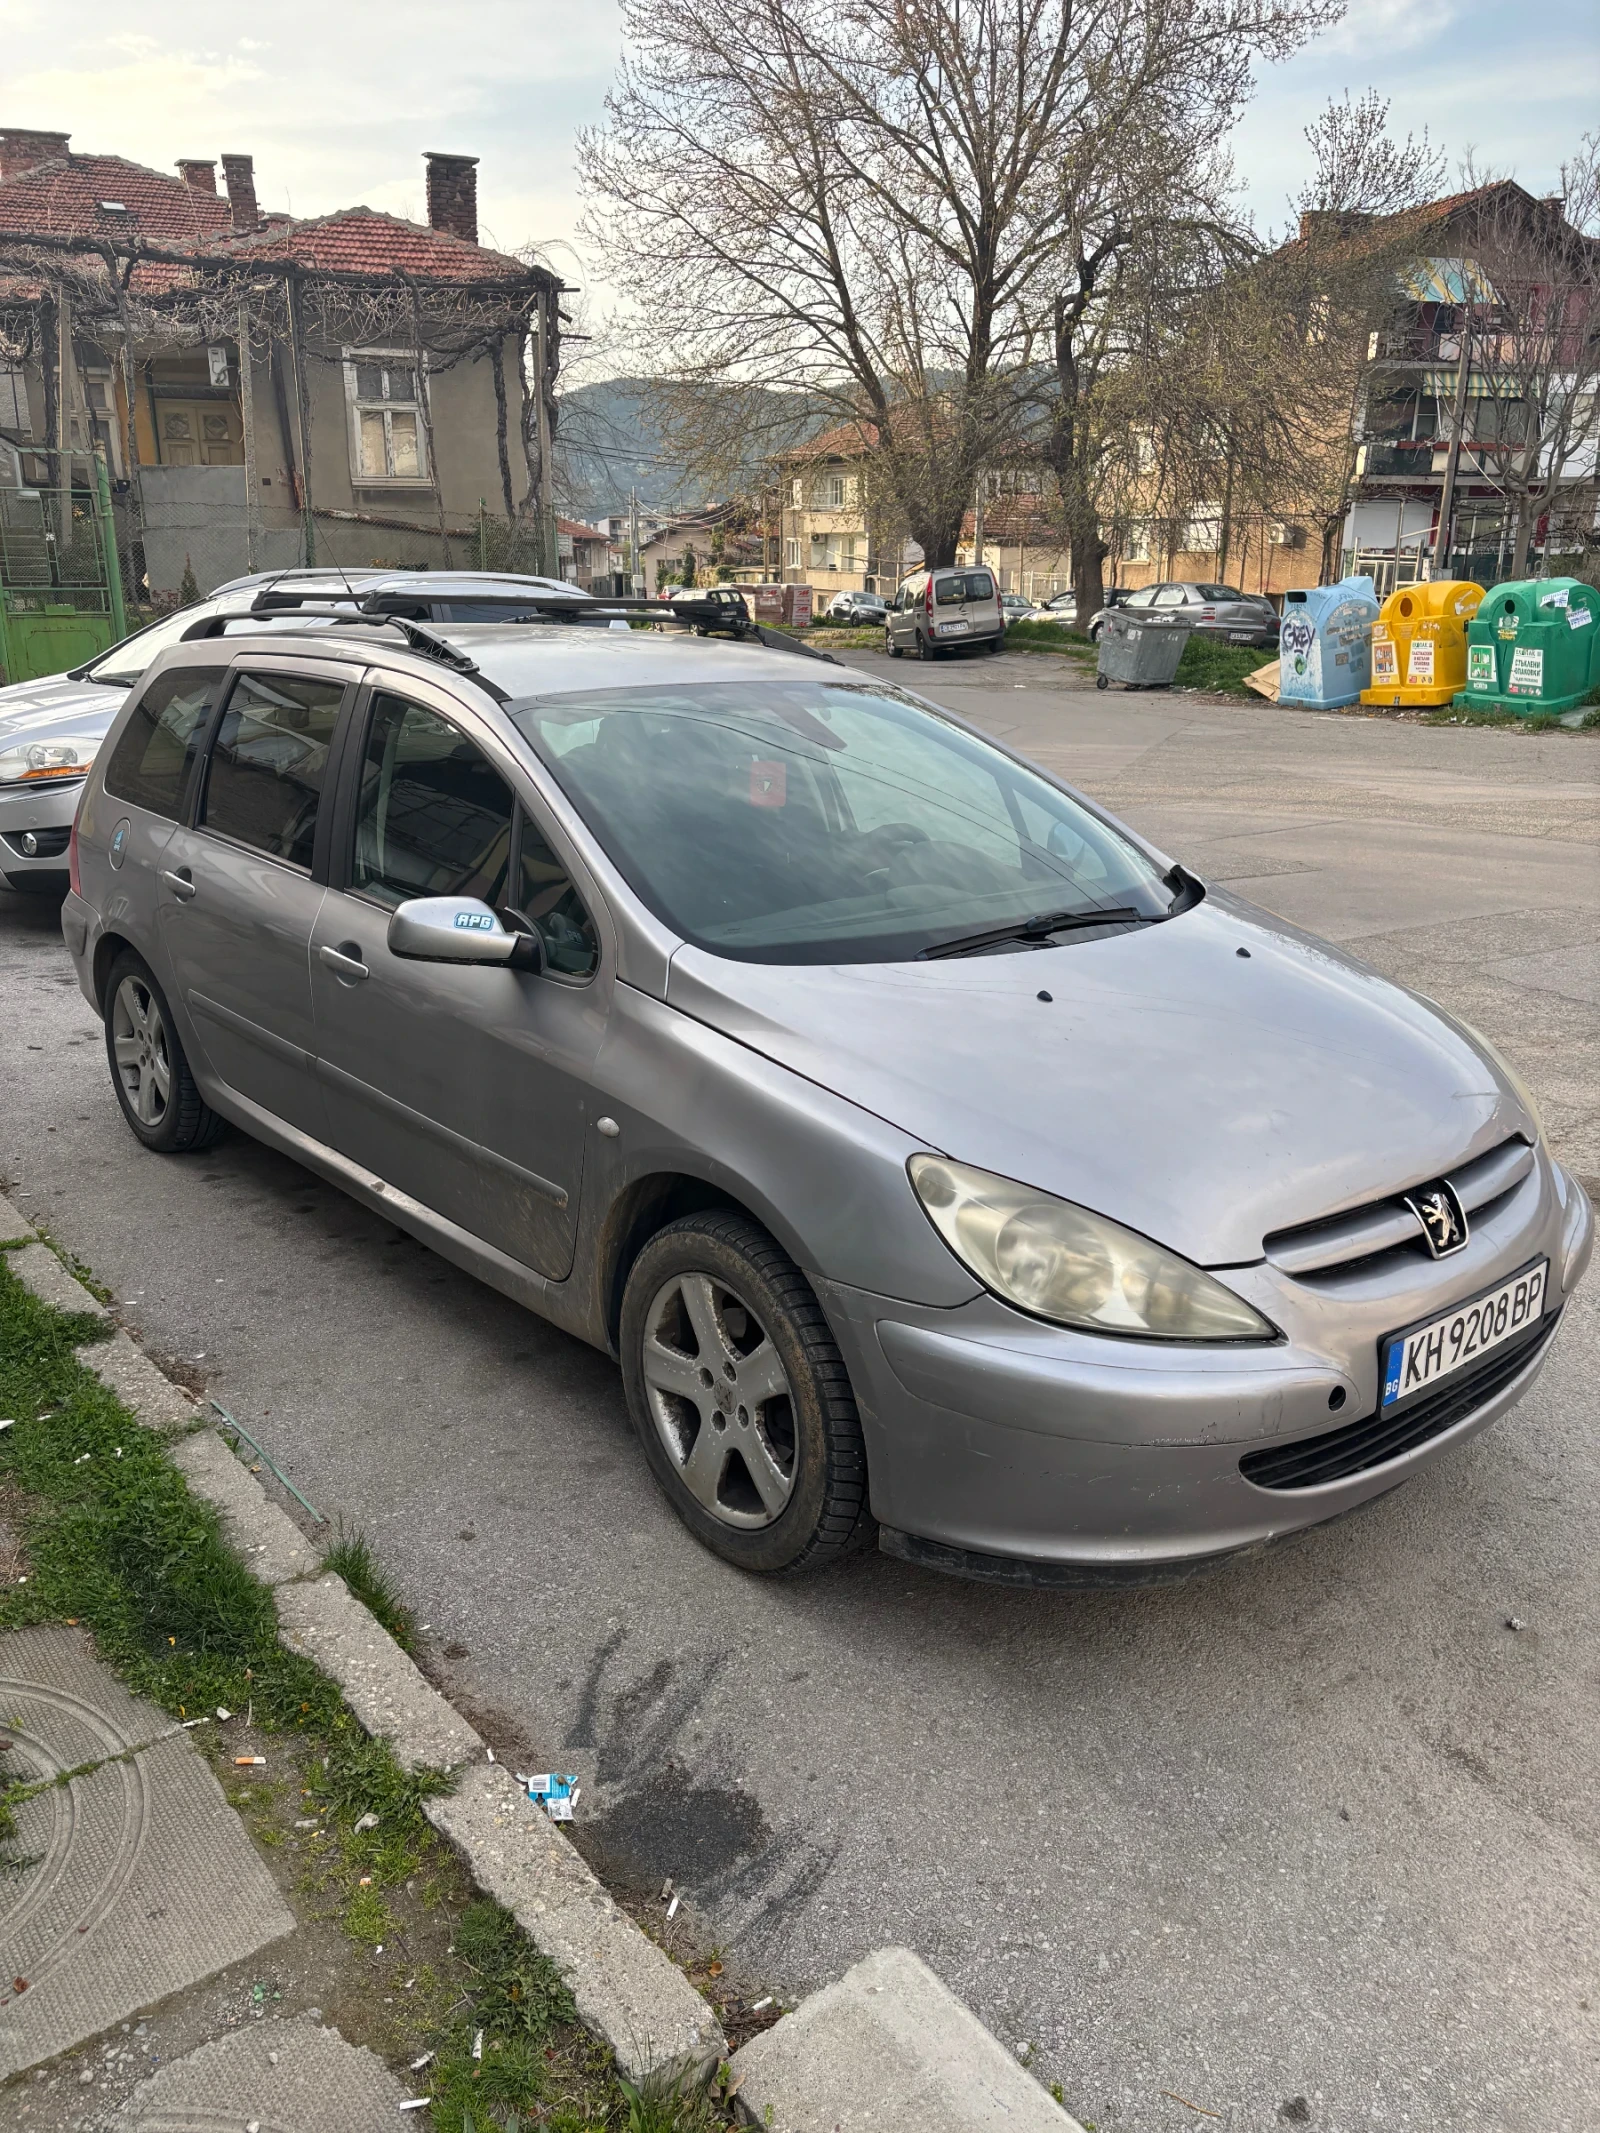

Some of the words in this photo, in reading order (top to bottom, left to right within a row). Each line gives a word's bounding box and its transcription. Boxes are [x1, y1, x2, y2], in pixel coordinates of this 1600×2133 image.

[1515, 659, 1541, 669] СТЪКЛЕНИ
[457, 914, 491, 929] APG
[1404, 1325, 1445, 1388] KH
[1450, 1292, 1509, 1364] 9208
[1511, 1272, 1542, 1328] BP
[1385, 1379, 1399, 1396] BG
